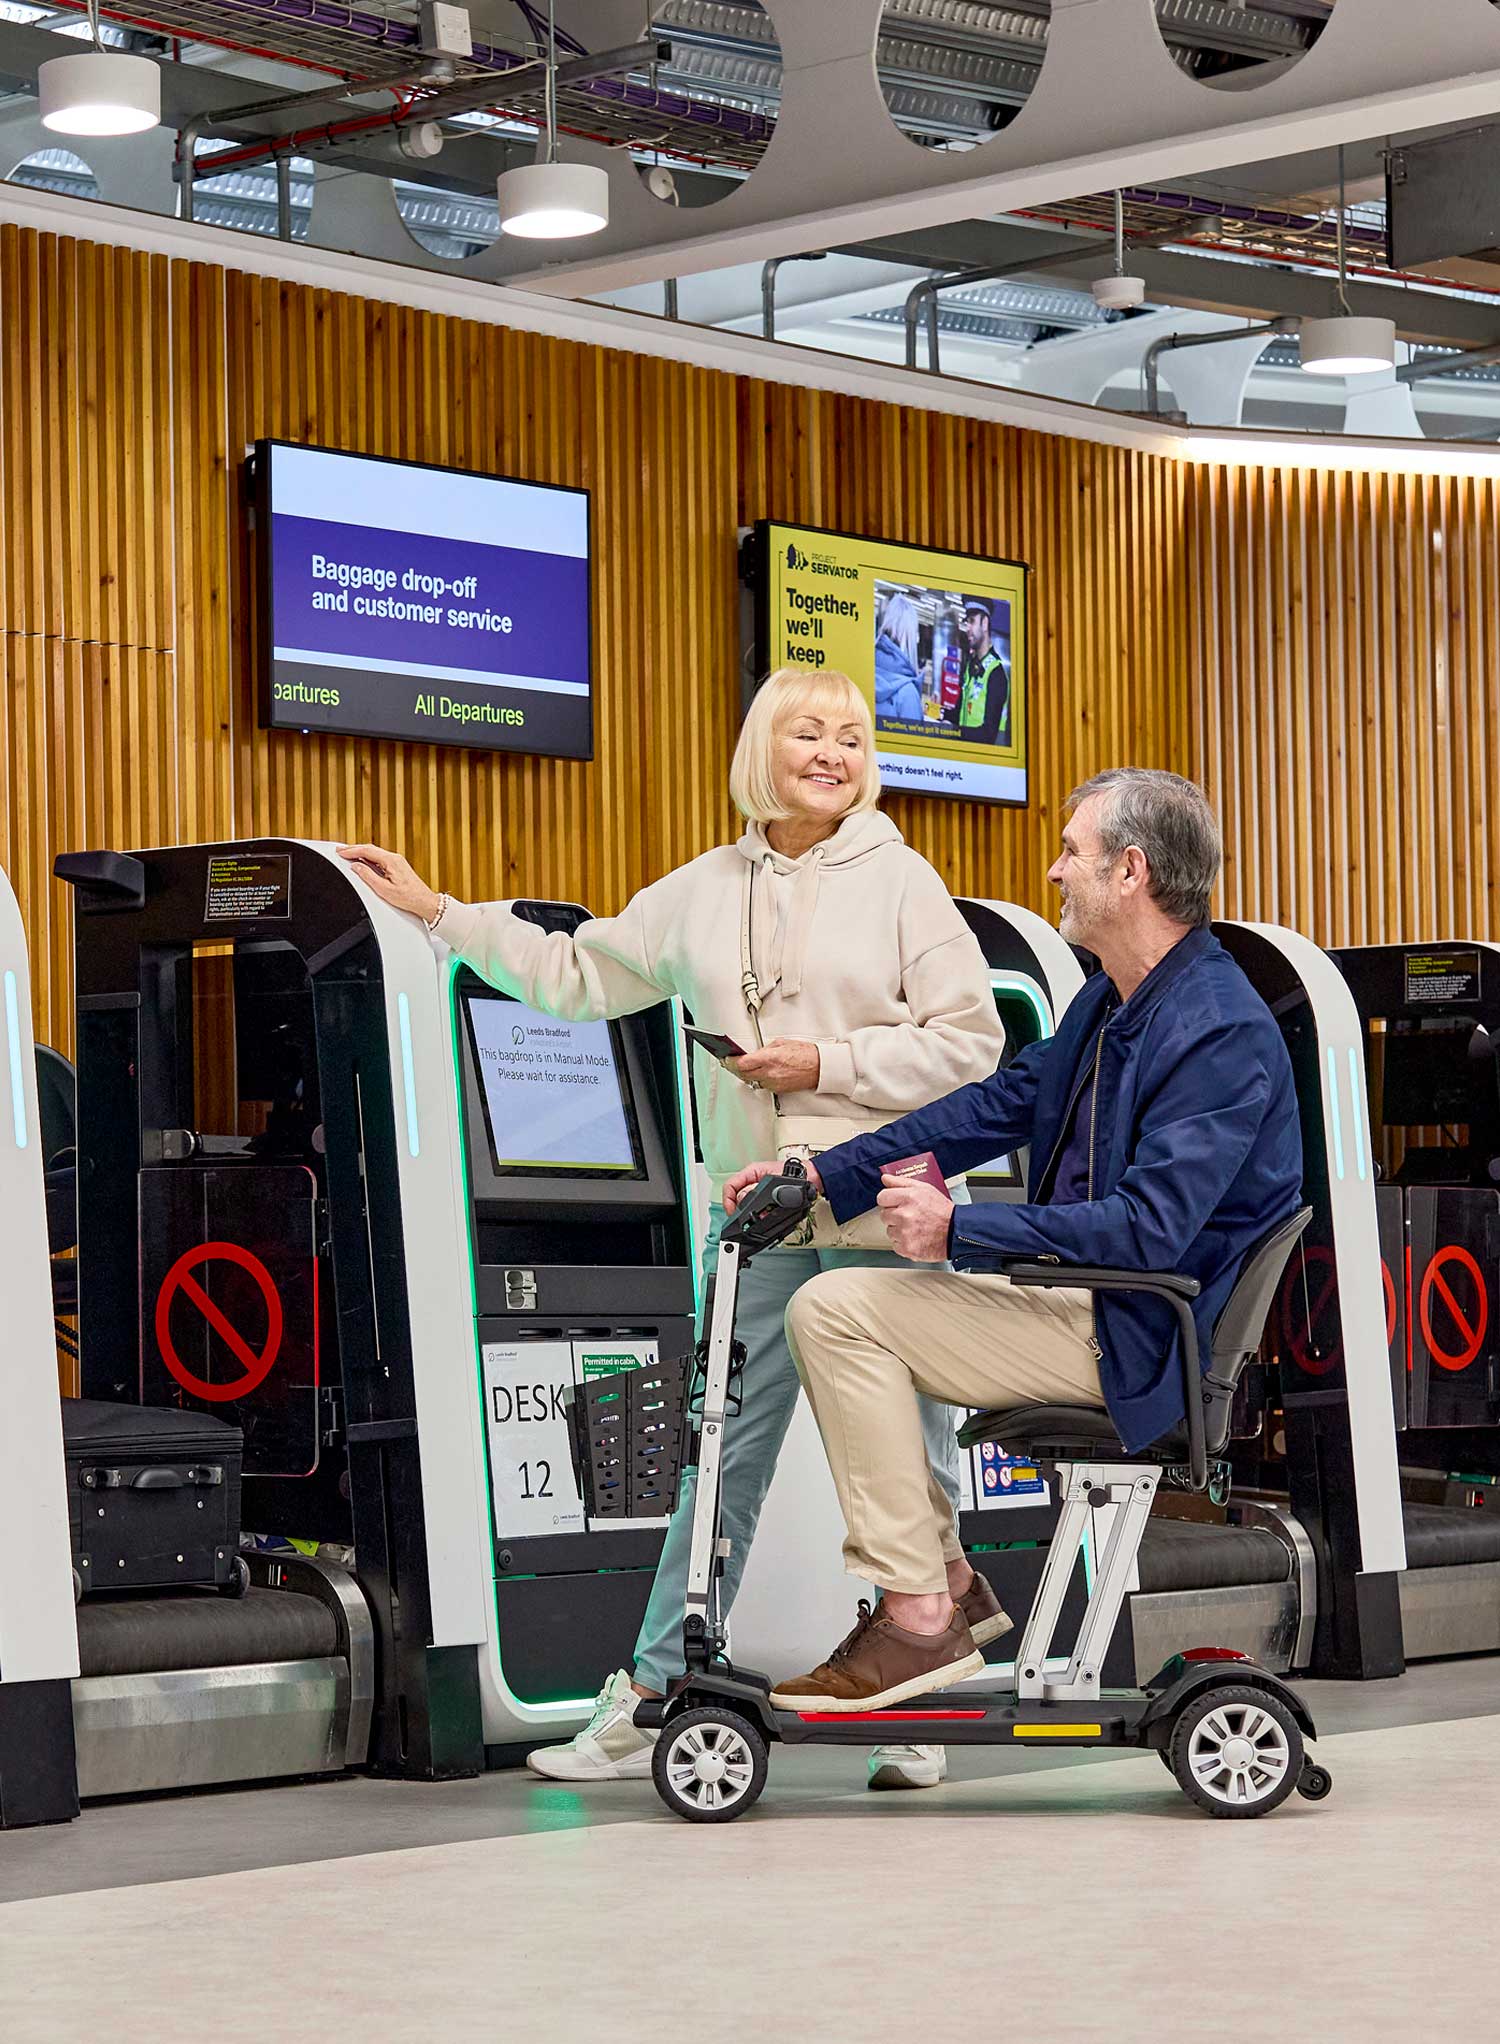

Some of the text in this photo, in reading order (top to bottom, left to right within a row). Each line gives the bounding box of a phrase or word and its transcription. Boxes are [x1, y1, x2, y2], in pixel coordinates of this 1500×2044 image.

[312, 555, 477, 600] Baggage drop-off
[811, 562, 859, 580] SERVATOR
[312, 590, 512, 634] and customer service
[786, 587, 859, 621] Together,
[786, 618, 823, 638] we'll
[787, 640, 825, 668] keep
[414, 694, 524, 726] All Departures
[905, 766, 930, 777] doesn't
[931, 768, 944, 778] feel
[526, 1027, 571, 1038] Leeds Bradford
[480, 1048, 497, 1060] This
[499, 1050, 533, 1064] bagdrop
[536, 1051, 542, 1062] is
[544, 1052, 552, 1063] in
[554, 1052, 584, 1065] Manual
[498, 1068, 600, 1084] Please wait for assistance.
[584, 1356, 636, 1366] Permitted in cabin
[492, 1384, 568, 1423] DESK
[518, 1460, 553, 1499] 12
